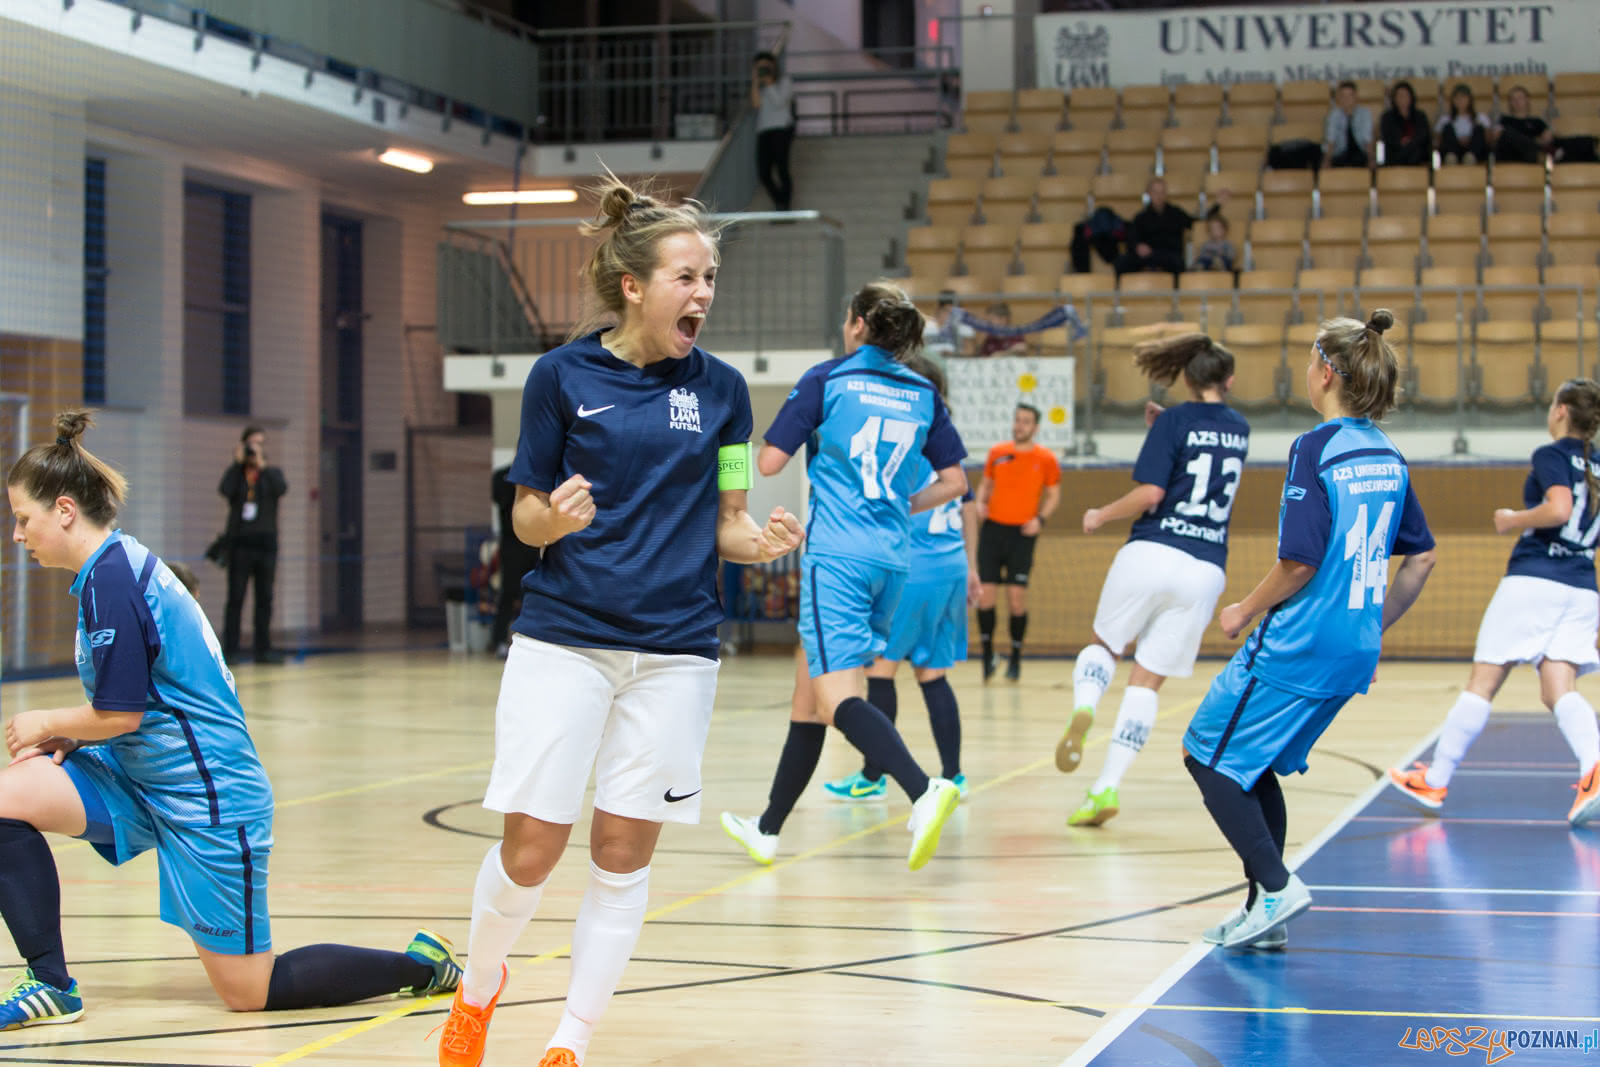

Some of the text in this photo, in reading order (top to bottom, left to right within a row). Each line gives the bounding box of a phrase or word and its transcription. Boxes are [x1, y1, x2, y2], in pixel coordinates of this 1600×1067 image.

[1158, 6, 1553, 55] UNIWERSYTET
[1446, 56, 1548, 77] Poznaniu
[670, 421, 703, 433] FUTSAL
[1186, 430, 1219, 447] AZS
[849, 415, 920, 501] 17
[1174, 452, 1243, 523] 13
[1343, 500, 1397, 610] 14
[193, 922, 239, 938] saller
